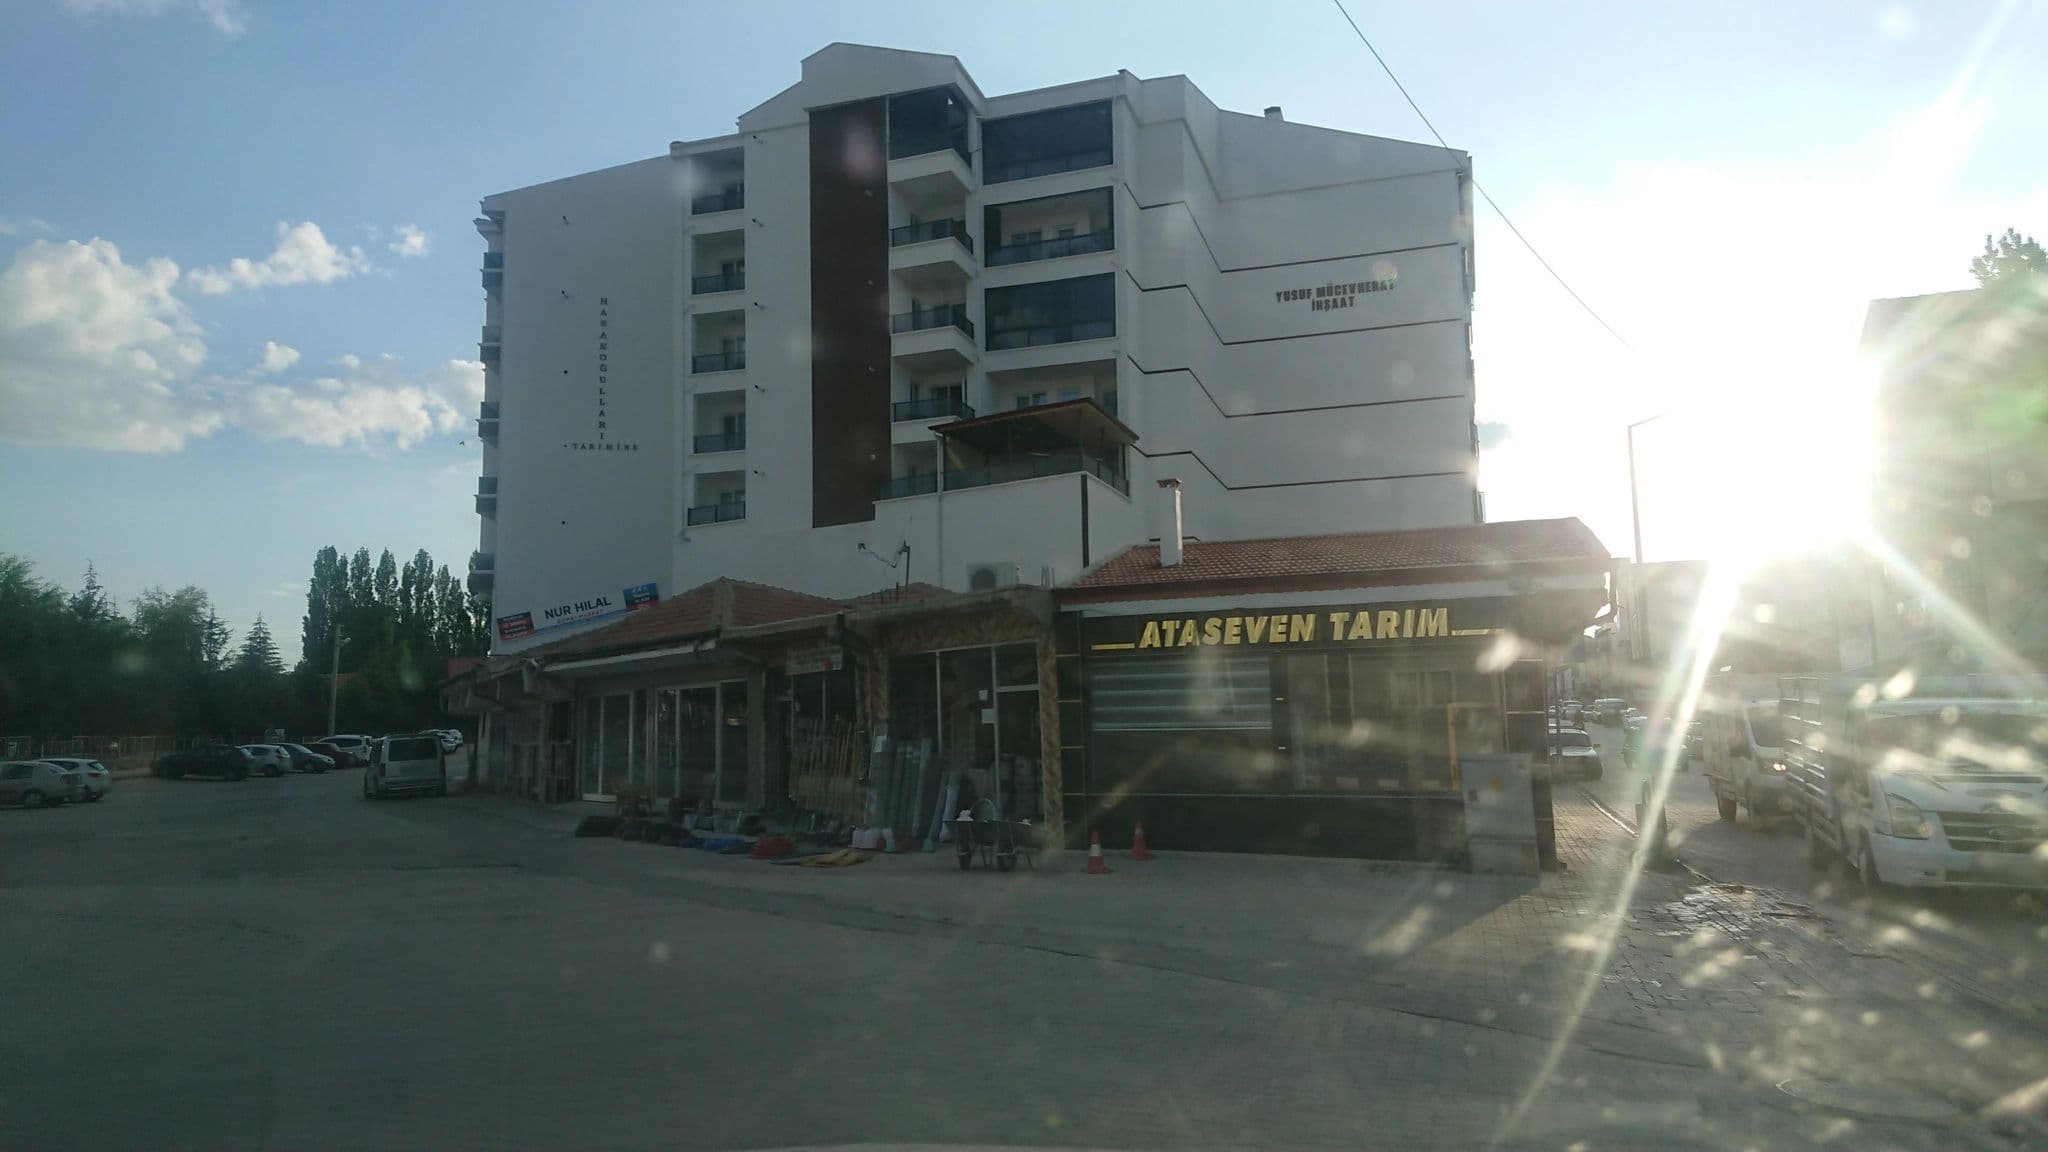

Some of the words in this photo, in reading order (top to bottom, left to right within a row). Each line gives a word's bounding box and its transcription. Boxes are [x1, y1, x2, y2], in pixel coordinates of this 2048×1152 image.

[1276, 288, 1312, 302] YUSUF
[545, 605, 571, 619] NUR
[1139, 614, 1317, 648] ATASEVEN
[1329, 607, 1448, 640] TARIM
